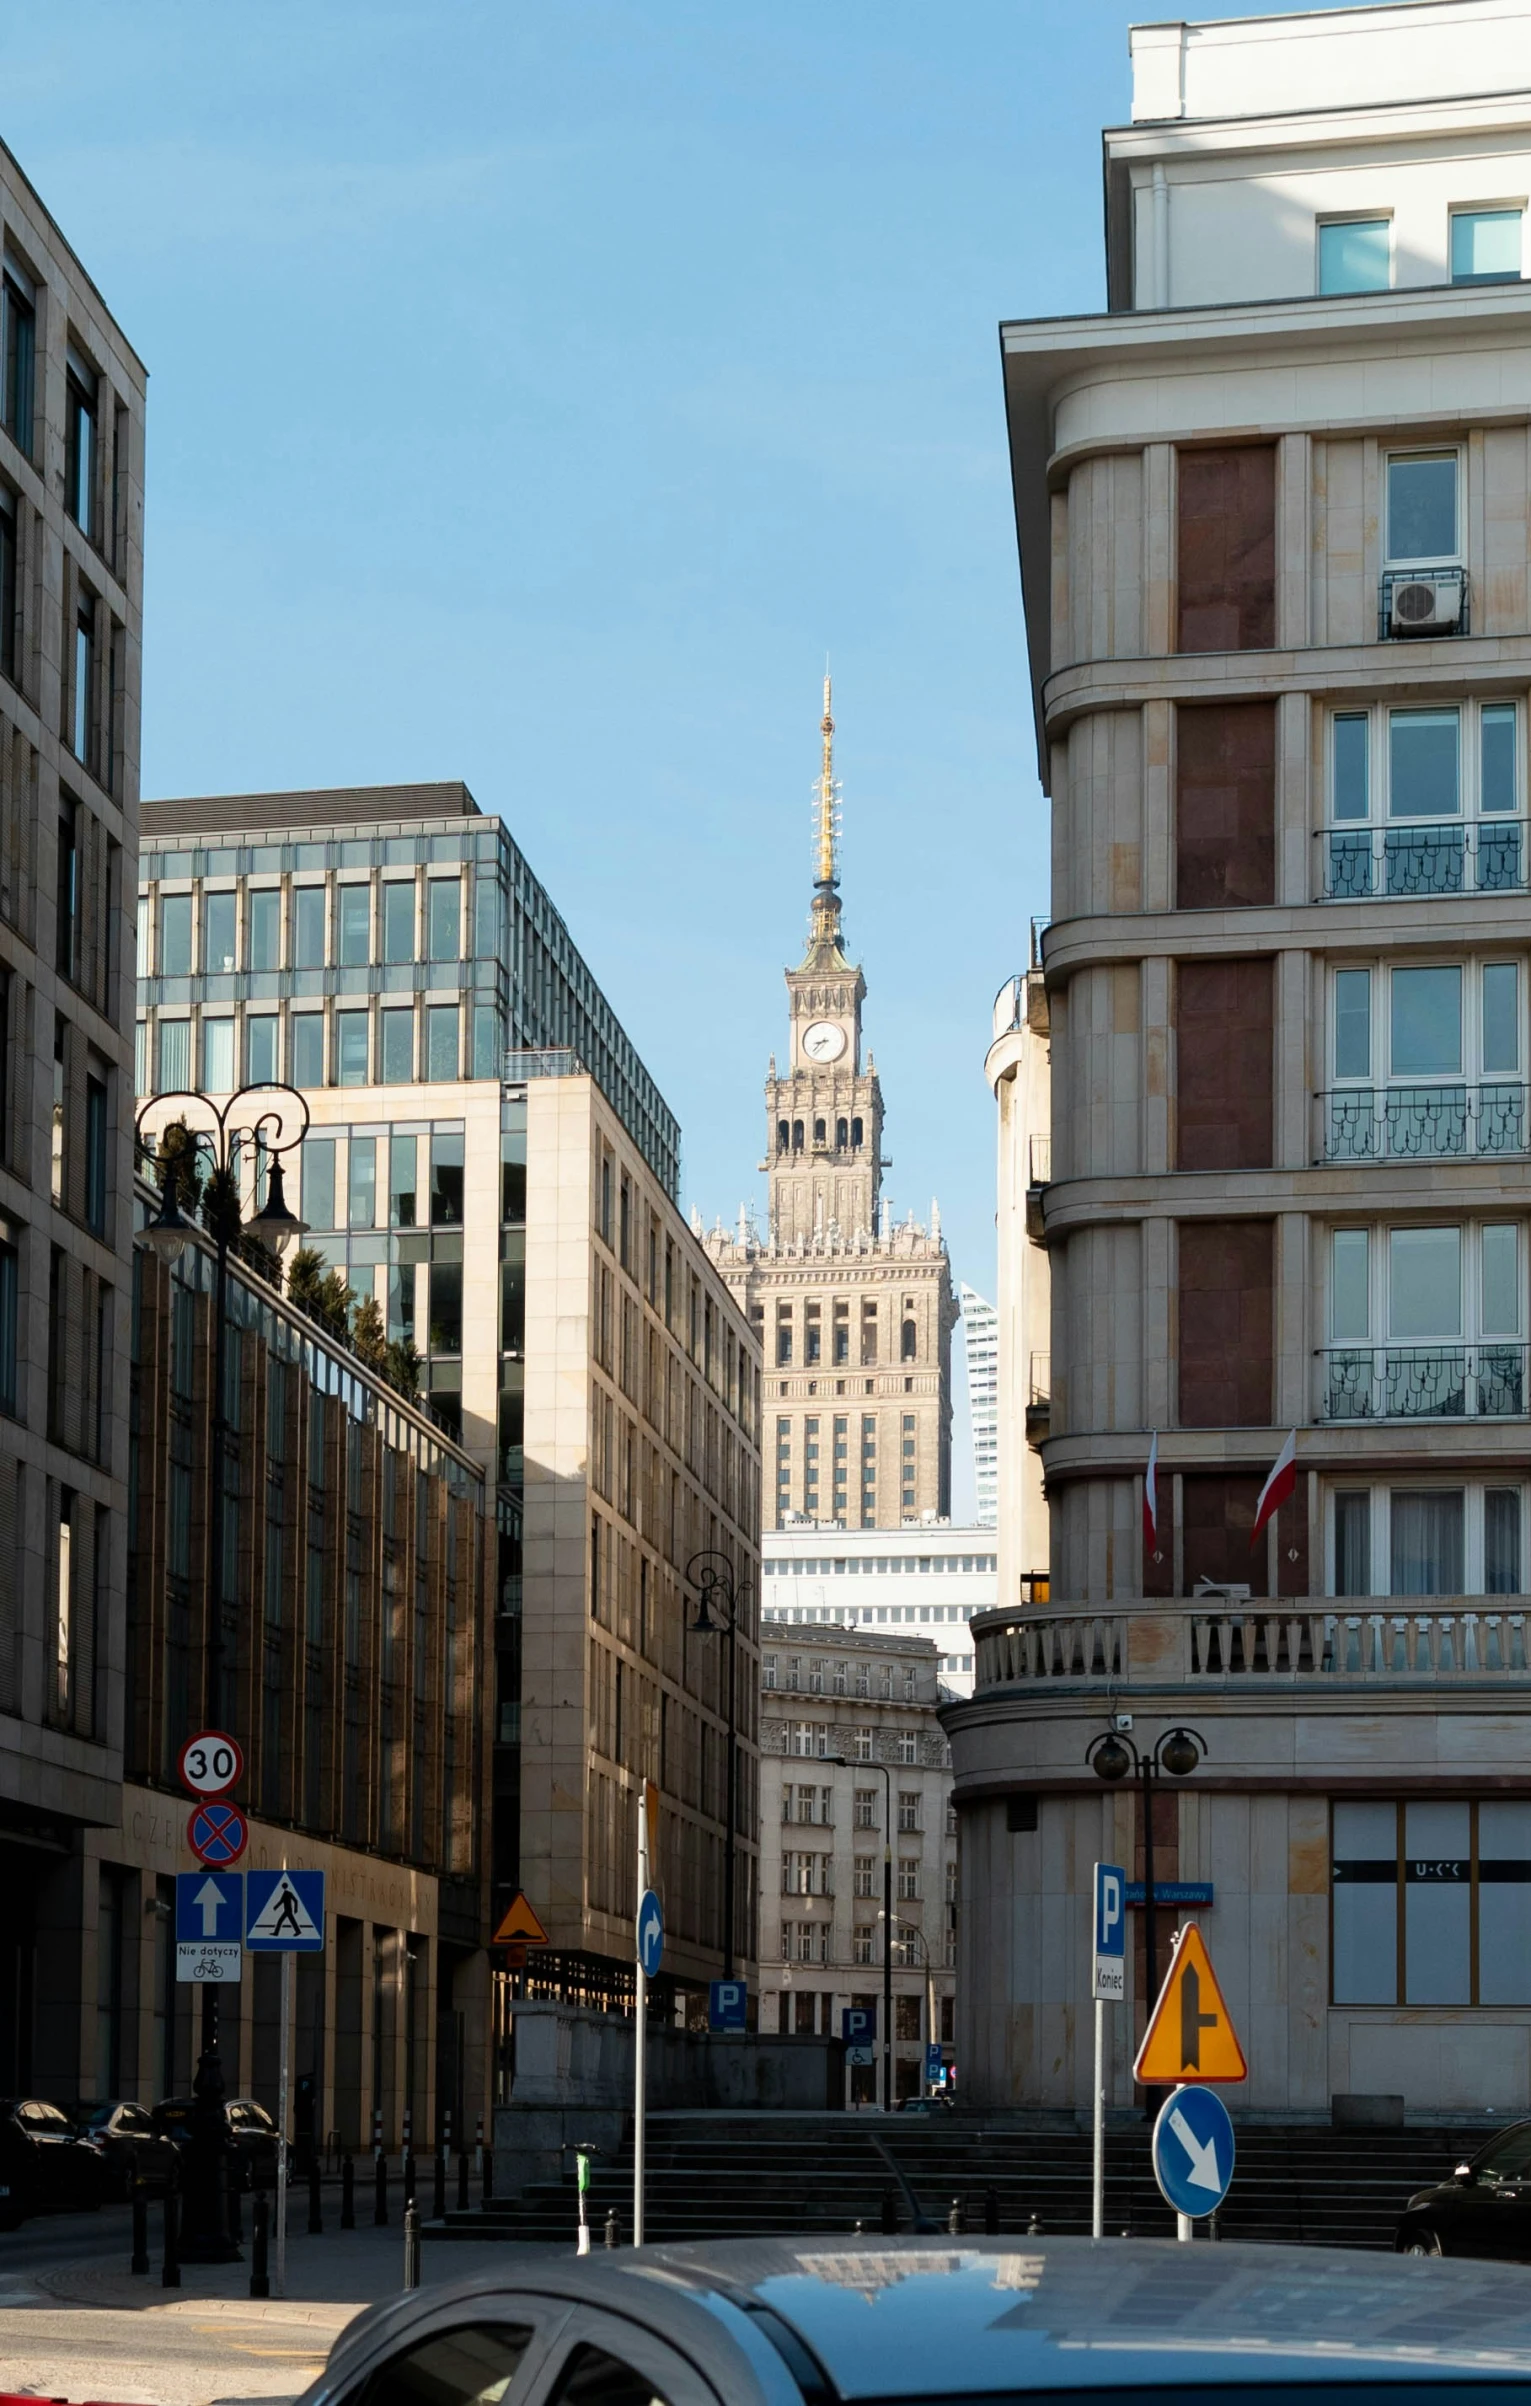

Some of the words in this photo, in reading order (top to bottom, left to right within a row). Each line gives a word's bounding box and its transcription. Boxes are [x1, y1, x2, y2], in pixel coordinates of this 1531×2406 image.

[188, 1748, 234, 1779] 30
[1162, 1888, 1207, 1902] Warszawy
[1103, 1875, 1120, 1944] P
[178, 1946, 198, 1956] Nie
[200, 1946, 239, 1959] dotyczy
[1097, 1967, 1123, 1990] Koniec
[718, 1984, 740, 2014] P
[849, 2011, 867, 2036] P
[929, 2045, 939, 2058] P
[929, 2064, 939, 2076] P
